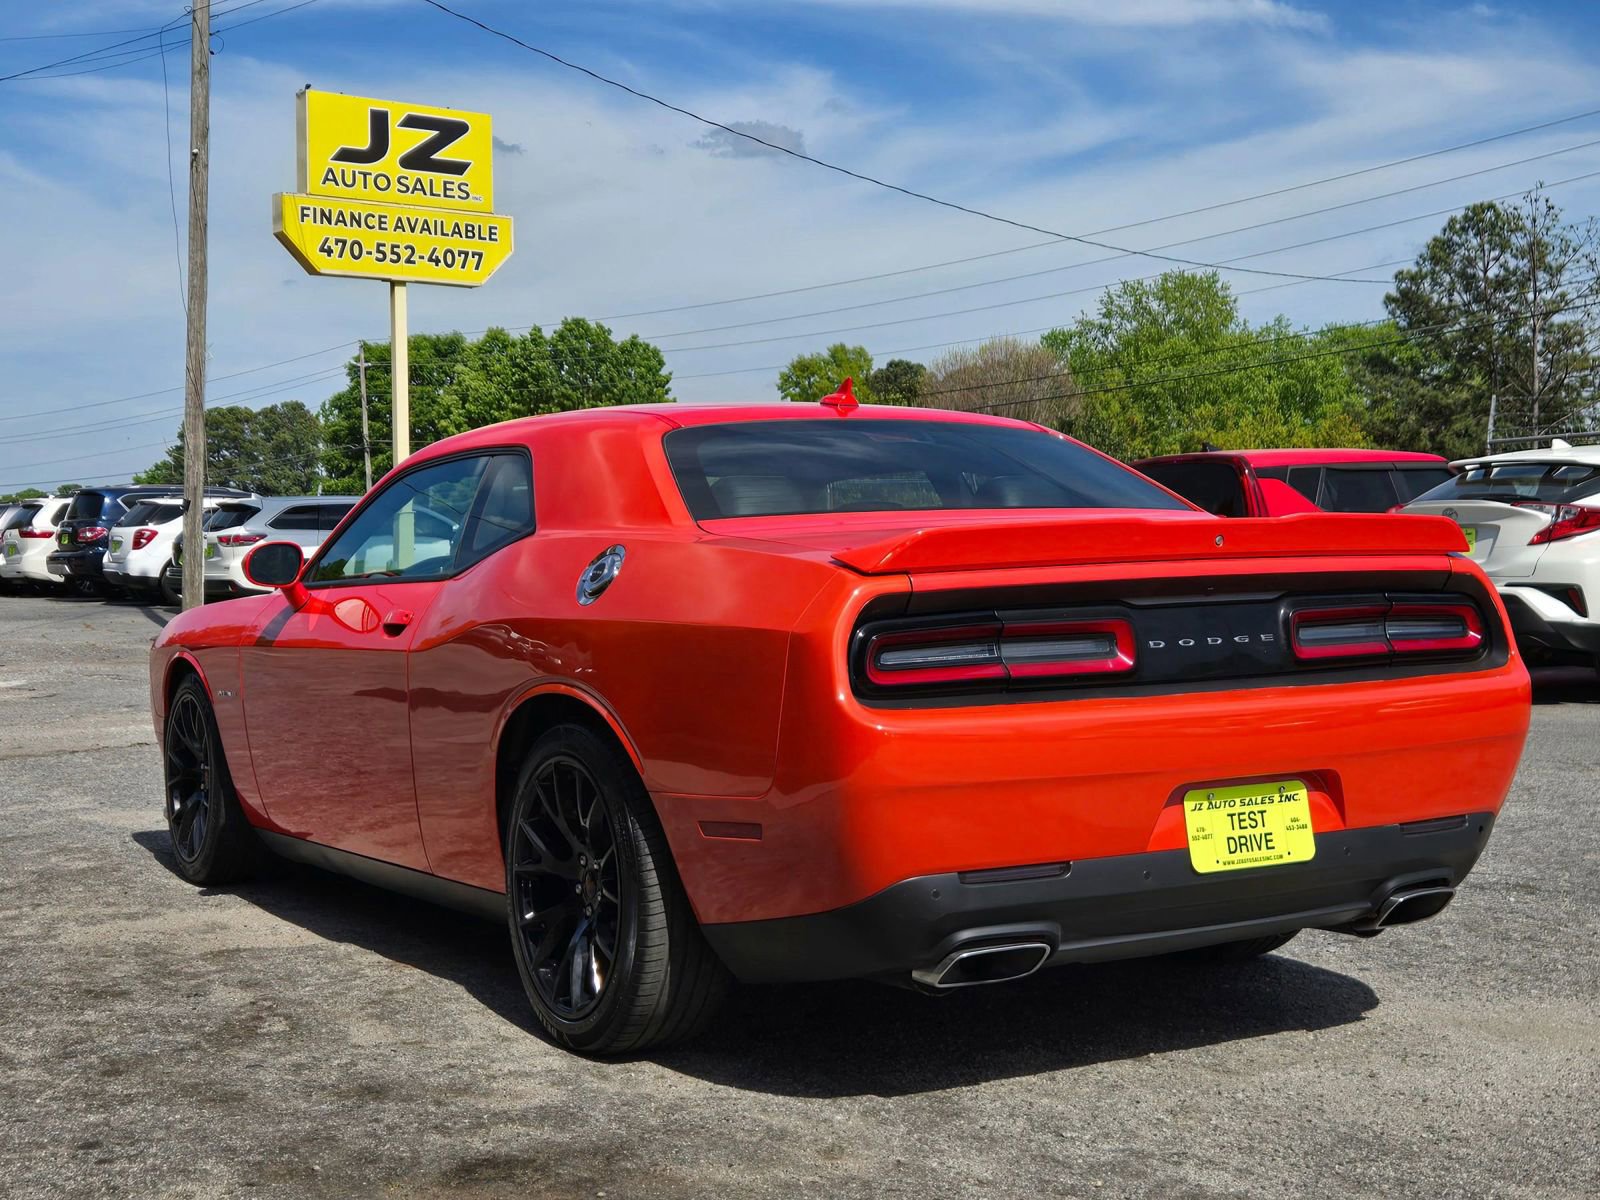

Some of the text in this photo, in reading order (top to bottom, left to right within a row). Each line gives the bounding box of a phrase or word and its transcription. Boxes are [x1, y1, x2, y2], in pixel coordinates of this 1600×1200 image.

[330, 108, 473, 176] JZ
[321, 167, 392, 192] AUTO
[396, 175, 470, 200] SALES
[300, 206, 499, 242] FINANCE AVAILABLE
[318, 237, 484, 271] 470-552-4077
[1149, 633, 1274, 648] DODGE
[1191, 802, 1204, 812] JZ
[1207, 799, 1236, 811] AUTO
[1239, 795, 1275, 807] SALES
[1227, 810, 1267, 831] TEST
[1227, 832, 1275, 855] DRIVE
